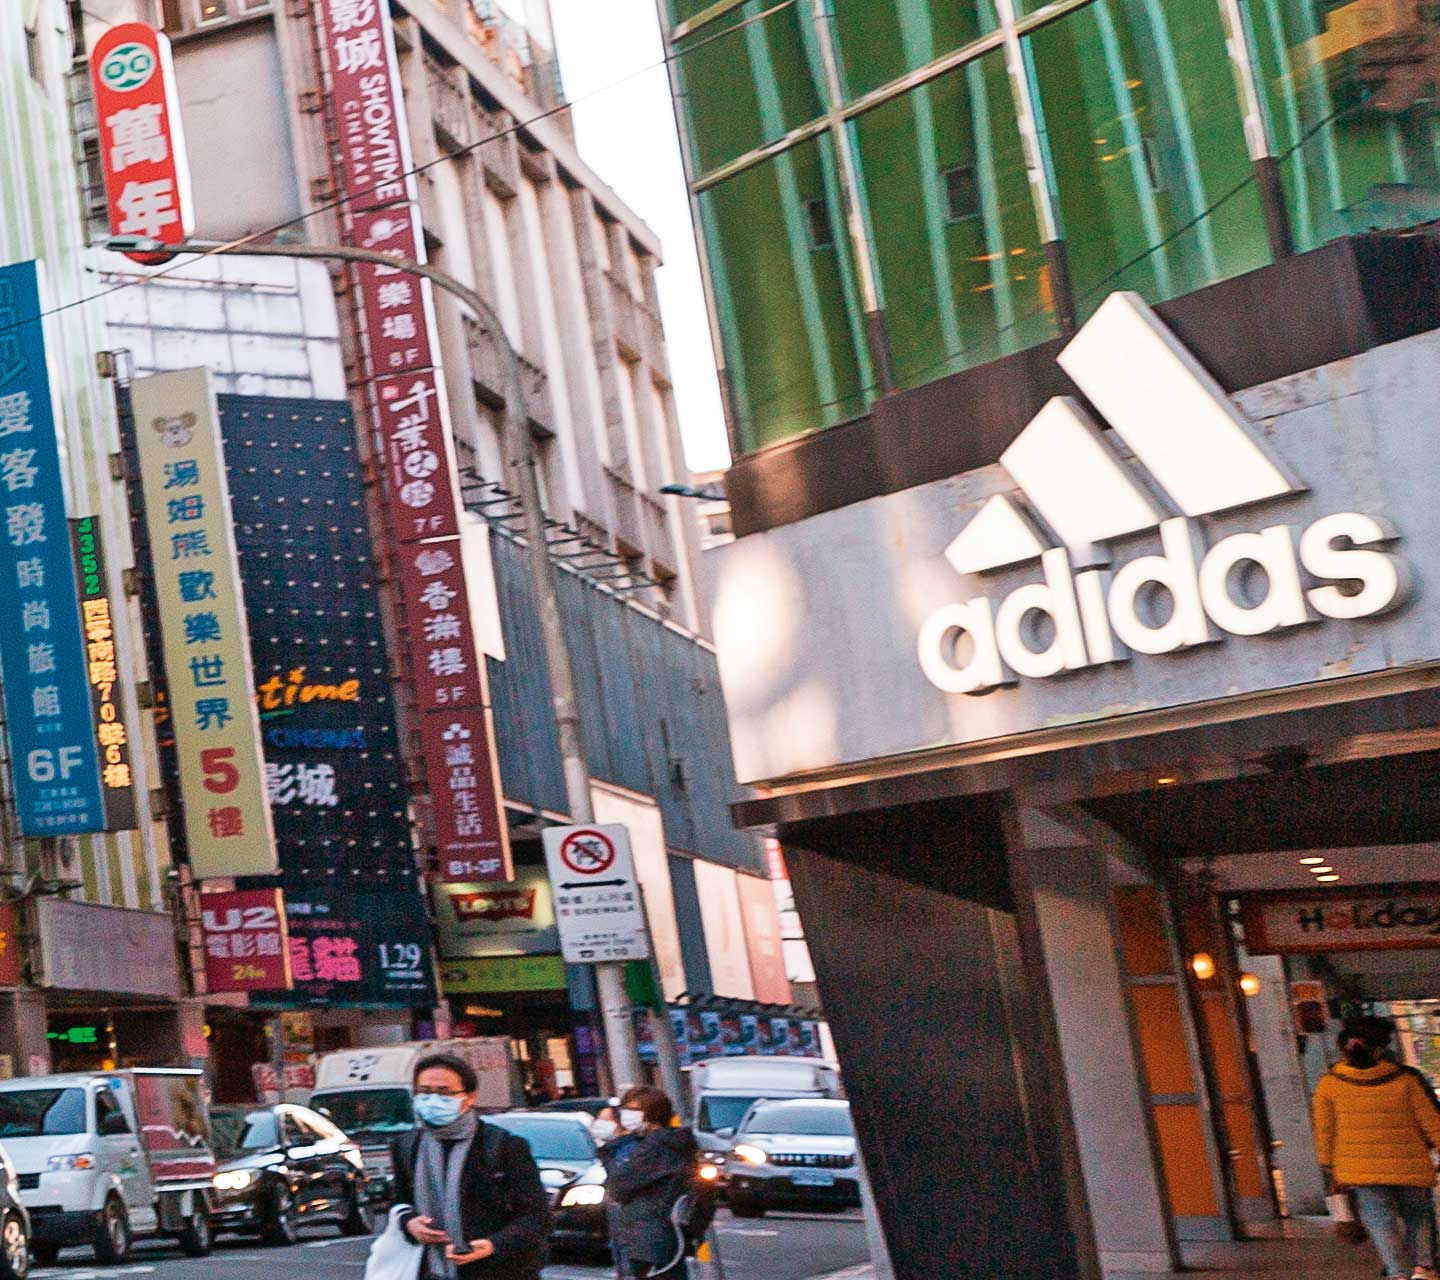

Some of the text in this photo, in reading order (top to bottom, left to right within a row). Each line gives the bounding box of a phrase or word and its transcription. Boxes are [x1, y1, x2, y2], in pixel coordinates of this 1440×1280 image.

[105, 102, 179, 238] 萬年
[359, 73, 405, 202] SHOWTIME
[16, 556, 62, 719] 時尚旅館
[161, 457, 234, 732] 湯姆熊歡樂世界
[917, 512, 1411, 696] adidas
[26, 745, 85, 784] 6F
[202, 906, 277, 931] U2
[205, 933, 281, 959] 電影館
